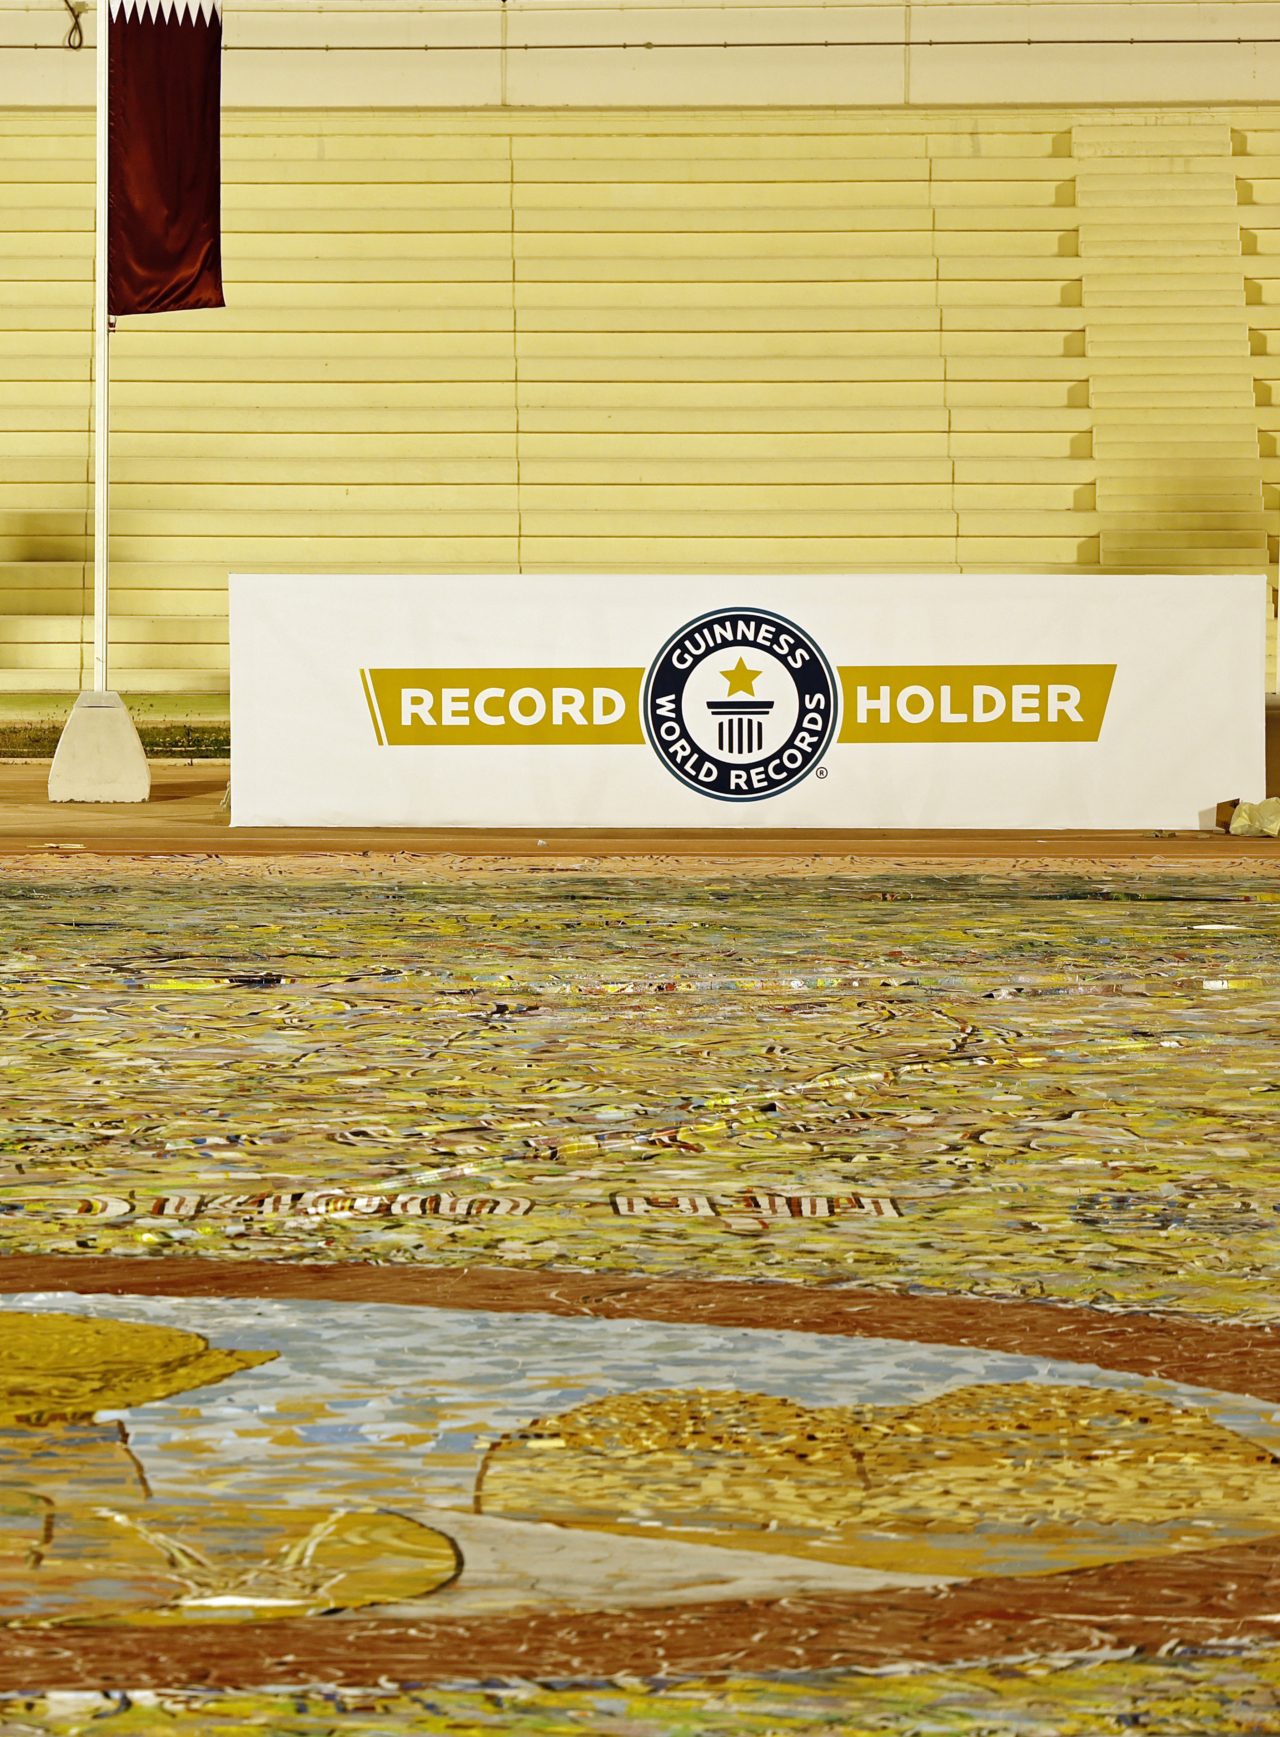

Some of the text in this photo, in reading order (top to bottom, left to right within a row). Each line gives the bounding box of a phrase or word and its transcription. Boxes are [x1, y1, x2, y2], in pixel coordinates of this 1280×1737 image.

[671, 620, 810, 669] GUINNESS
[401, 684, 1084, 726] RECORD HOLDER
[655, 693, 826, 790] WORLD RECORDS
